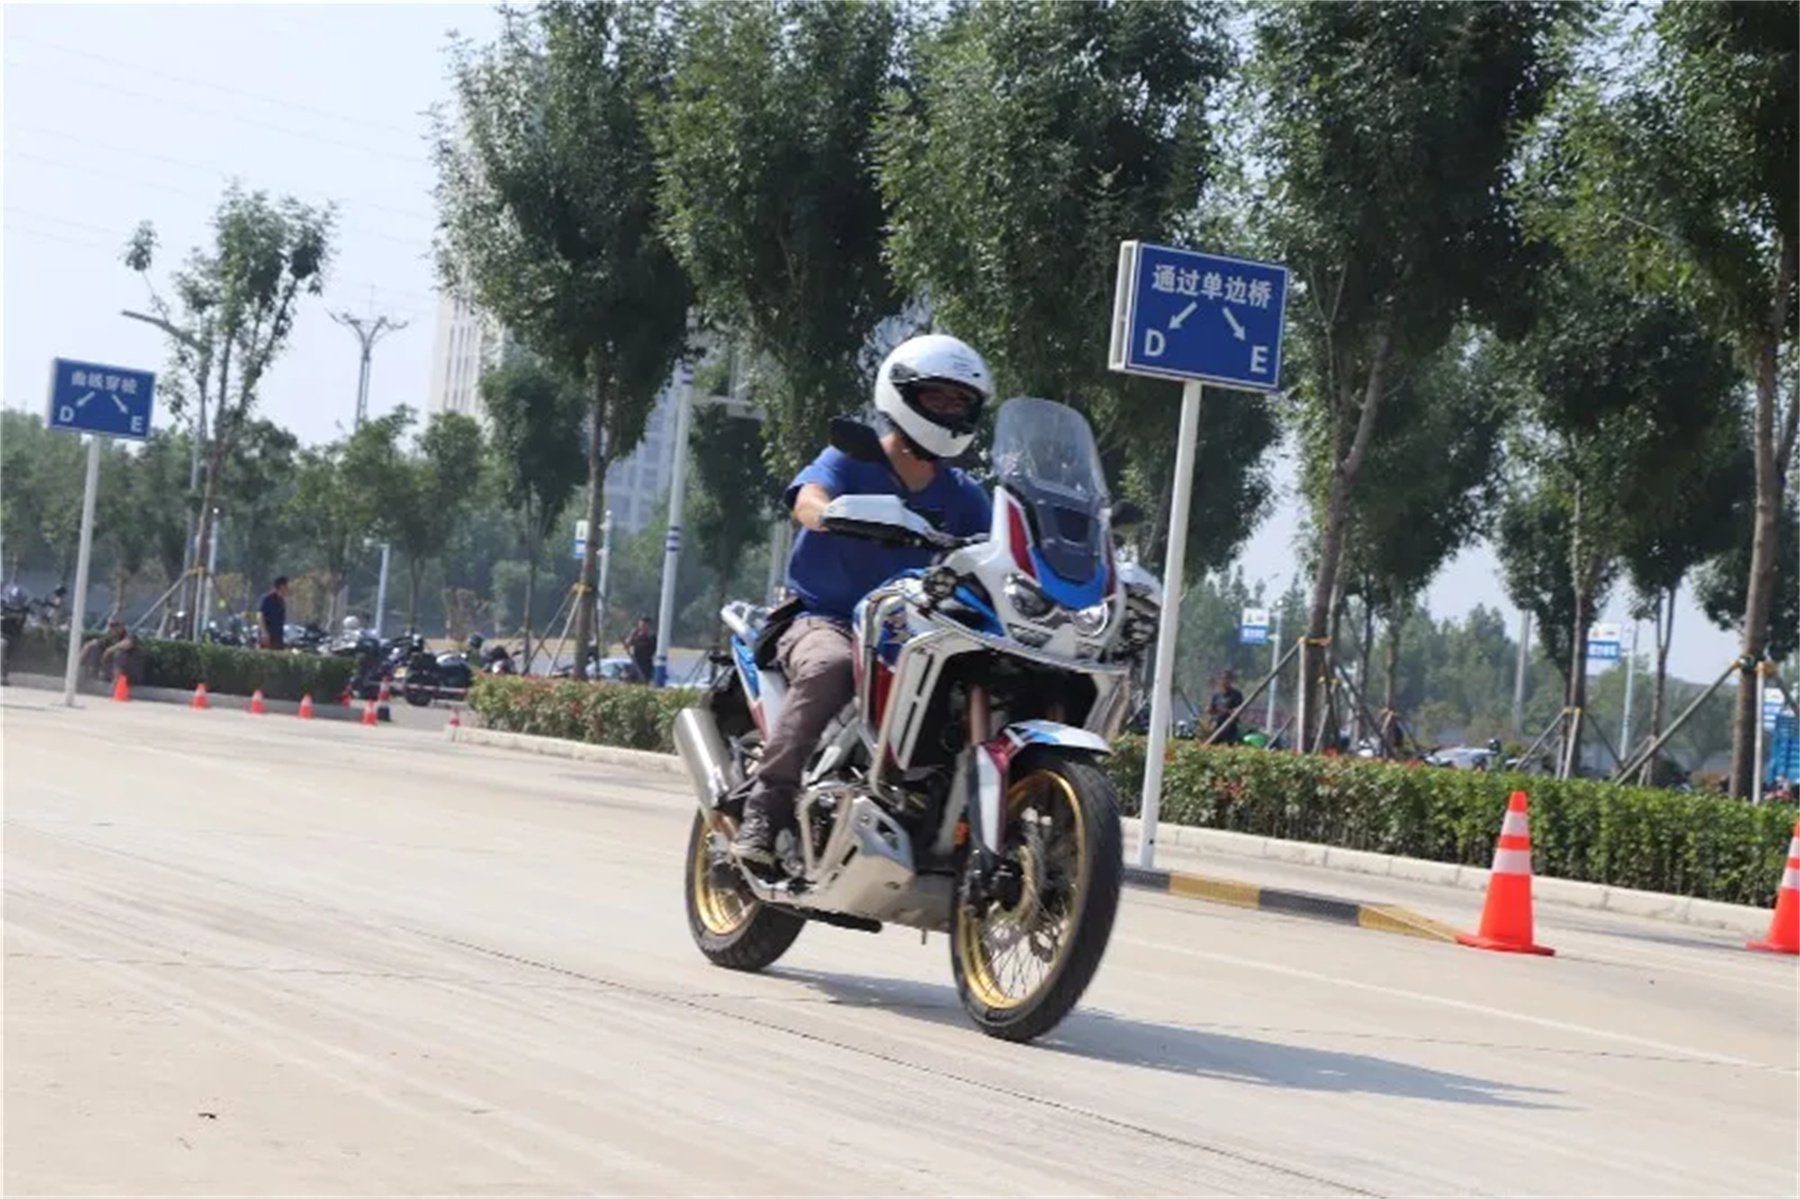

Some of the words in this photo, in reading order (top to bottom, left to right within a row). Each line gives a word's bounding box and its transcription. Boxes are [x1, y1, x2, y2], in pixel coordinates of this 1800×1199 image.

[1152, 264, 1272, 308] 通过单边桥
[1144, 328, 1166, 357] D
[1250, 345, 1269, 374] E
[60, 405, 74, 422] D
[131, 416, 142, 433] E
